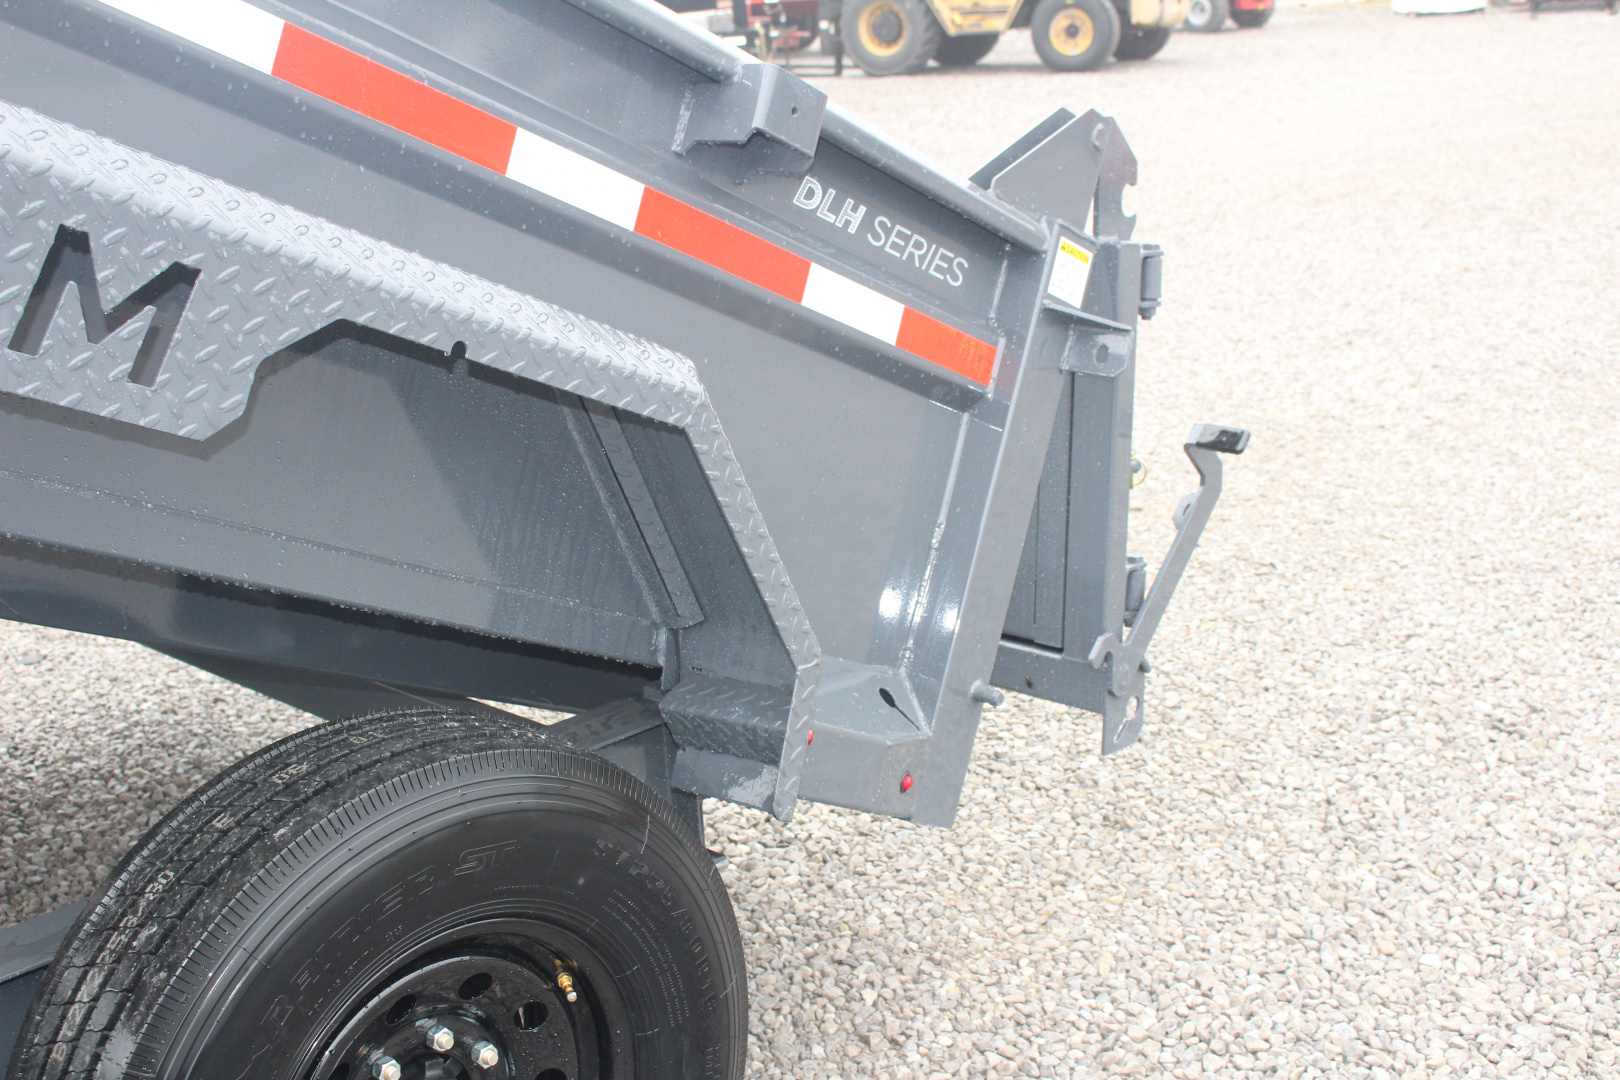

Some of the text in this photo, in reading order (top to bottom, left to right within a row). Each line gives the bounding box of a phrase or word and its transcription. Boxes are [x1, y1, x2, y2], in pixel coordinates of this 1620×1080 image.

[793, 176, 968, 287] DLH SERIES
[1065, 243, 1090, 265] CAUTION
[8, 223, 202, 389] M
